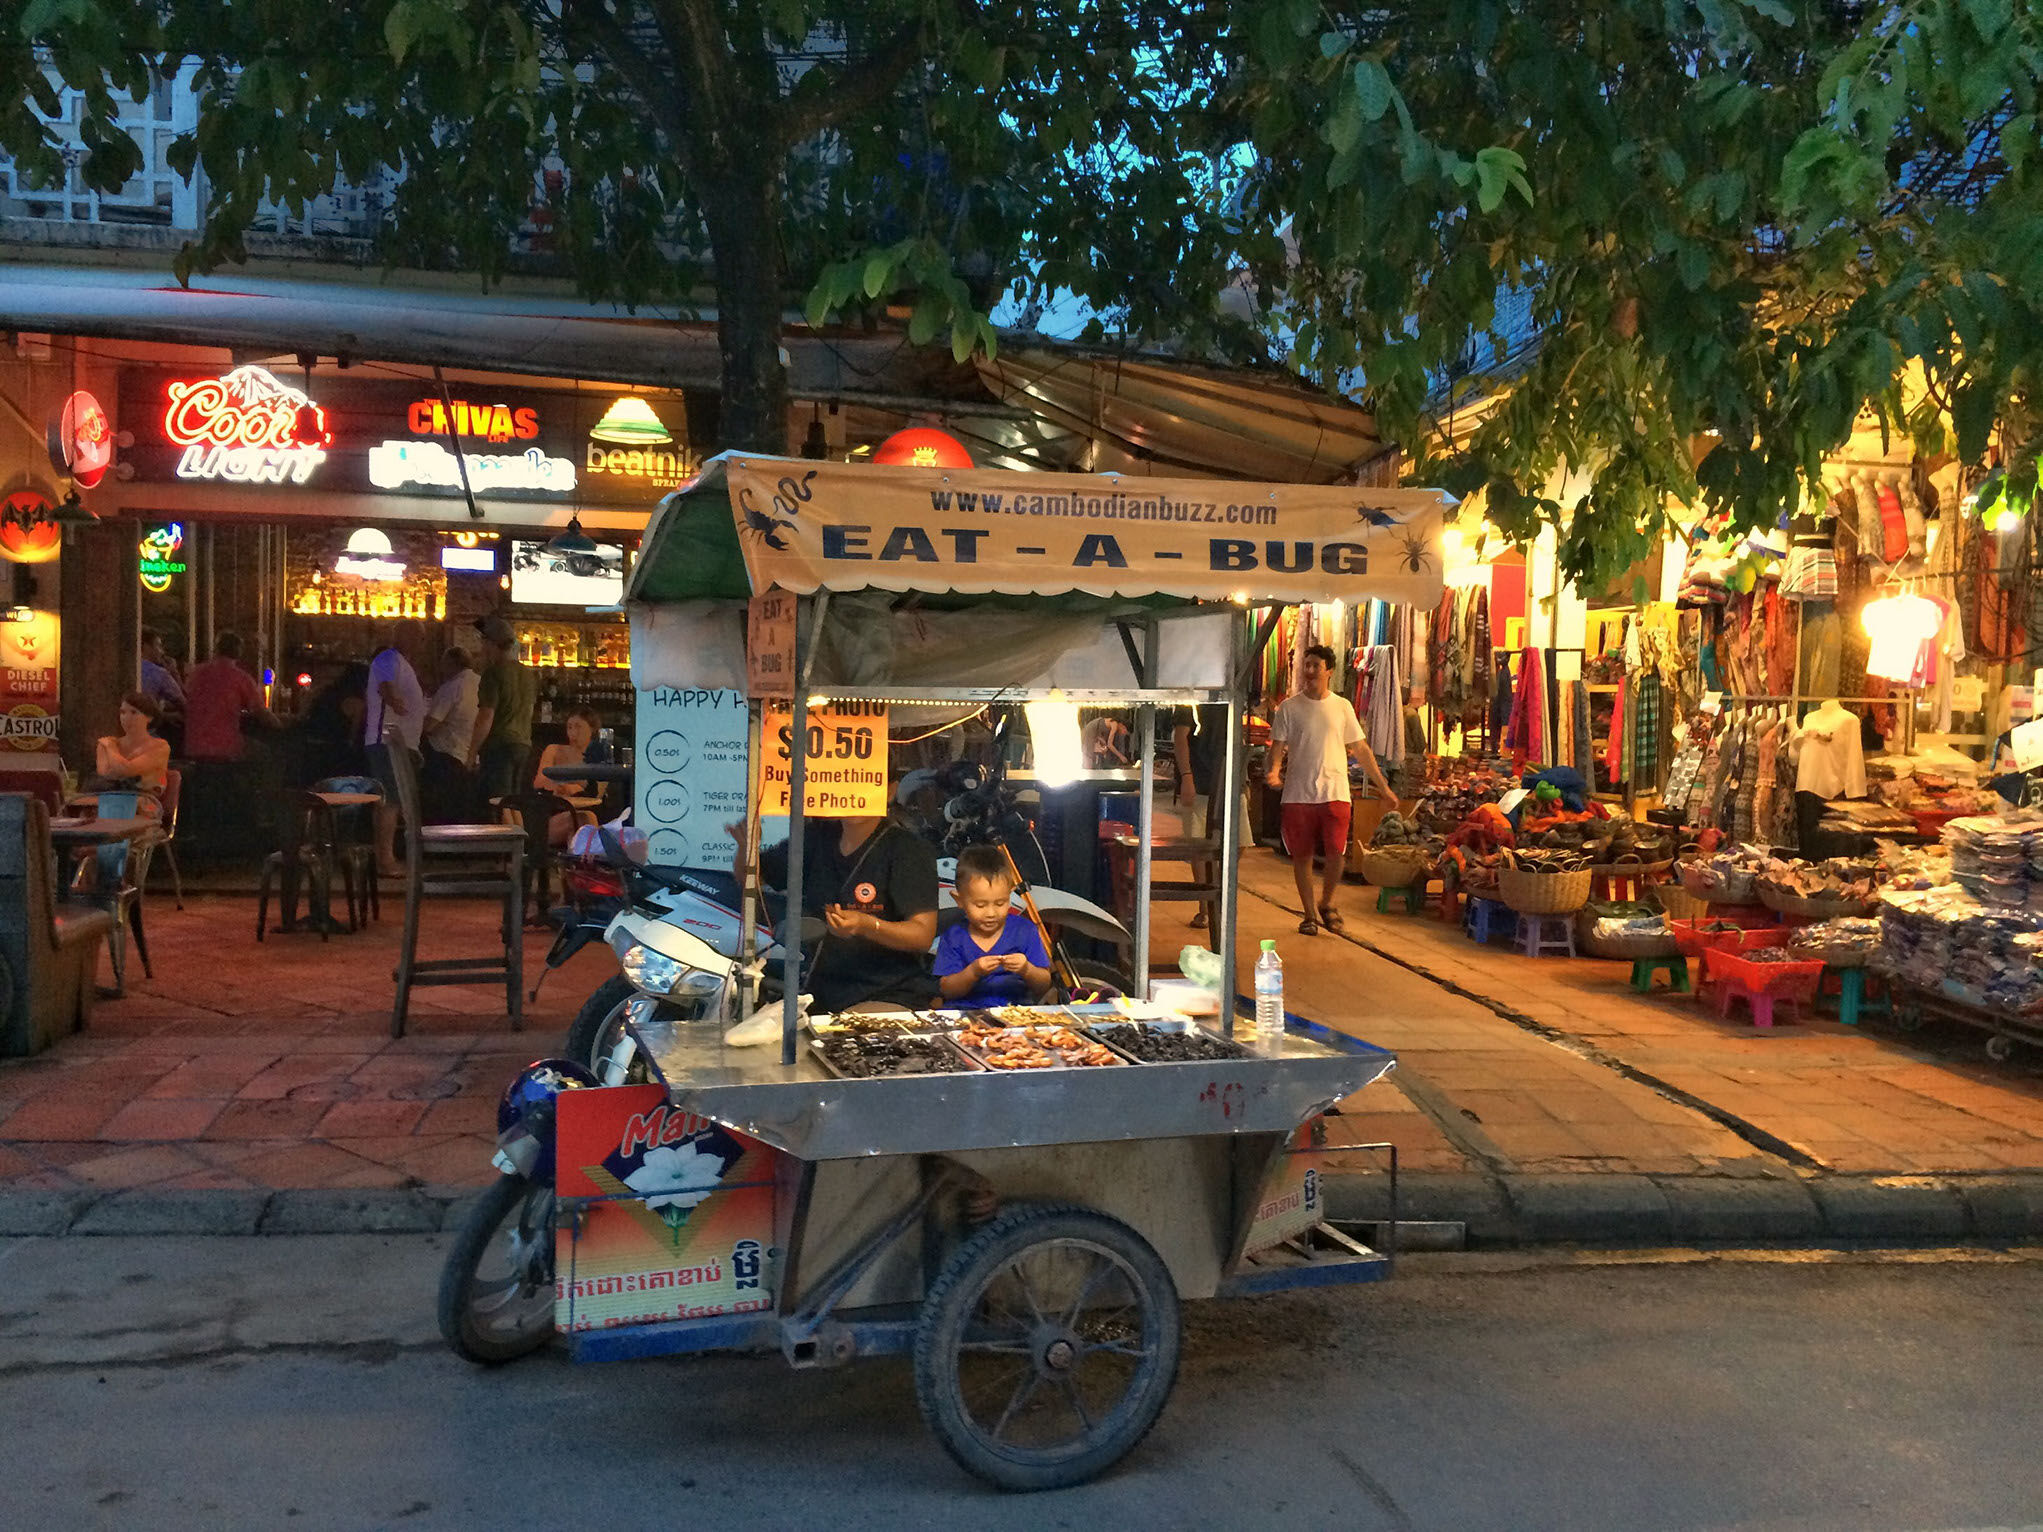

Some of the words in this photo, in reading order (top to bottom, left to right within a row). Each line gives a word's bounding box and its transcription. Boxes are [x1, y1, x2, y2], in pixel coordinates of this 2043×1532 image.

[408, 401, 539, 440] CHIVAS
[176, 445, 327, 484] LIGHT
[586, 442, 703, 479] beatnik
[931, 490, 1277, 525] www.cambodianbuzz.com
[822, 525, 989, 563] EAT
[1072, 533, 1129, 568] A
[1209, 538, 1368, 575] BUG
[763, 599, 781, 620] EAT
[768, 627, 775, 646] A
[761, 653, 782, 673] BUG
[7, 670, 50, 680] DIESEL
[10, 681, 48, 692] CHIEF
[653, 690, 723, 709] HAPPY
[704, 740, 742, 750] ANCHOR
[703, 753, 728, 761] 10AM
[765, 765, 794, 786] Buy
[703, 791, 729, 801] TIGER
[820, 792, 866, 809] Photo
[703, 804, 721, 812] 7PM
[702, 842, 735, 851] CLASSIC
